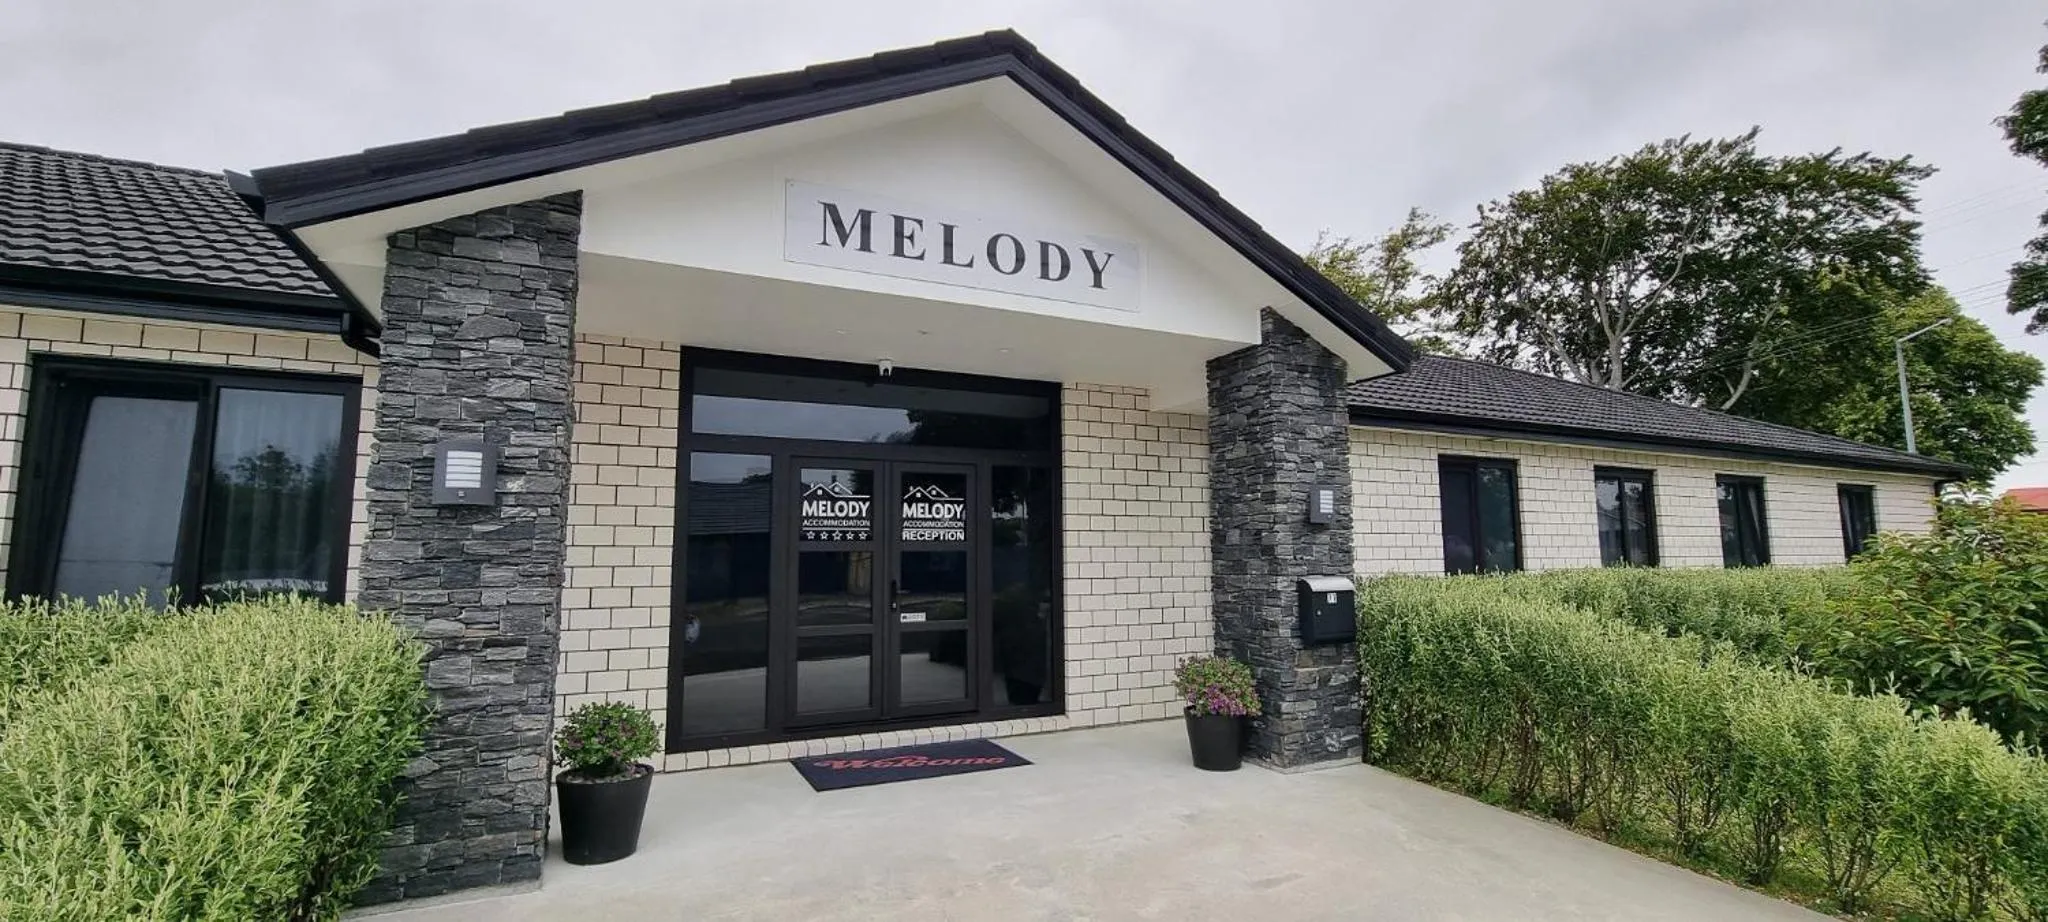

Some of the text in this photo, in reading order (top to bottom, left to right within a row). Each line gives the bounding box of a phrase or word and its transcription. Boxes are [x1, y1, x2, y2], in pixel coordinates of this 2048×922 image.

[816, 200, 1115, 289] MELODY
[802, 501, 870, 517] MELODY
[902, 503, 964, 518] MELODY
[802, 519, 870, 527] ACCOMMODATION
[902, 520, 964, 528] ACCOMMODATION
[902, 530, 964, 540] RECEPTION
[814, 755, 1006, 770] Welcome
